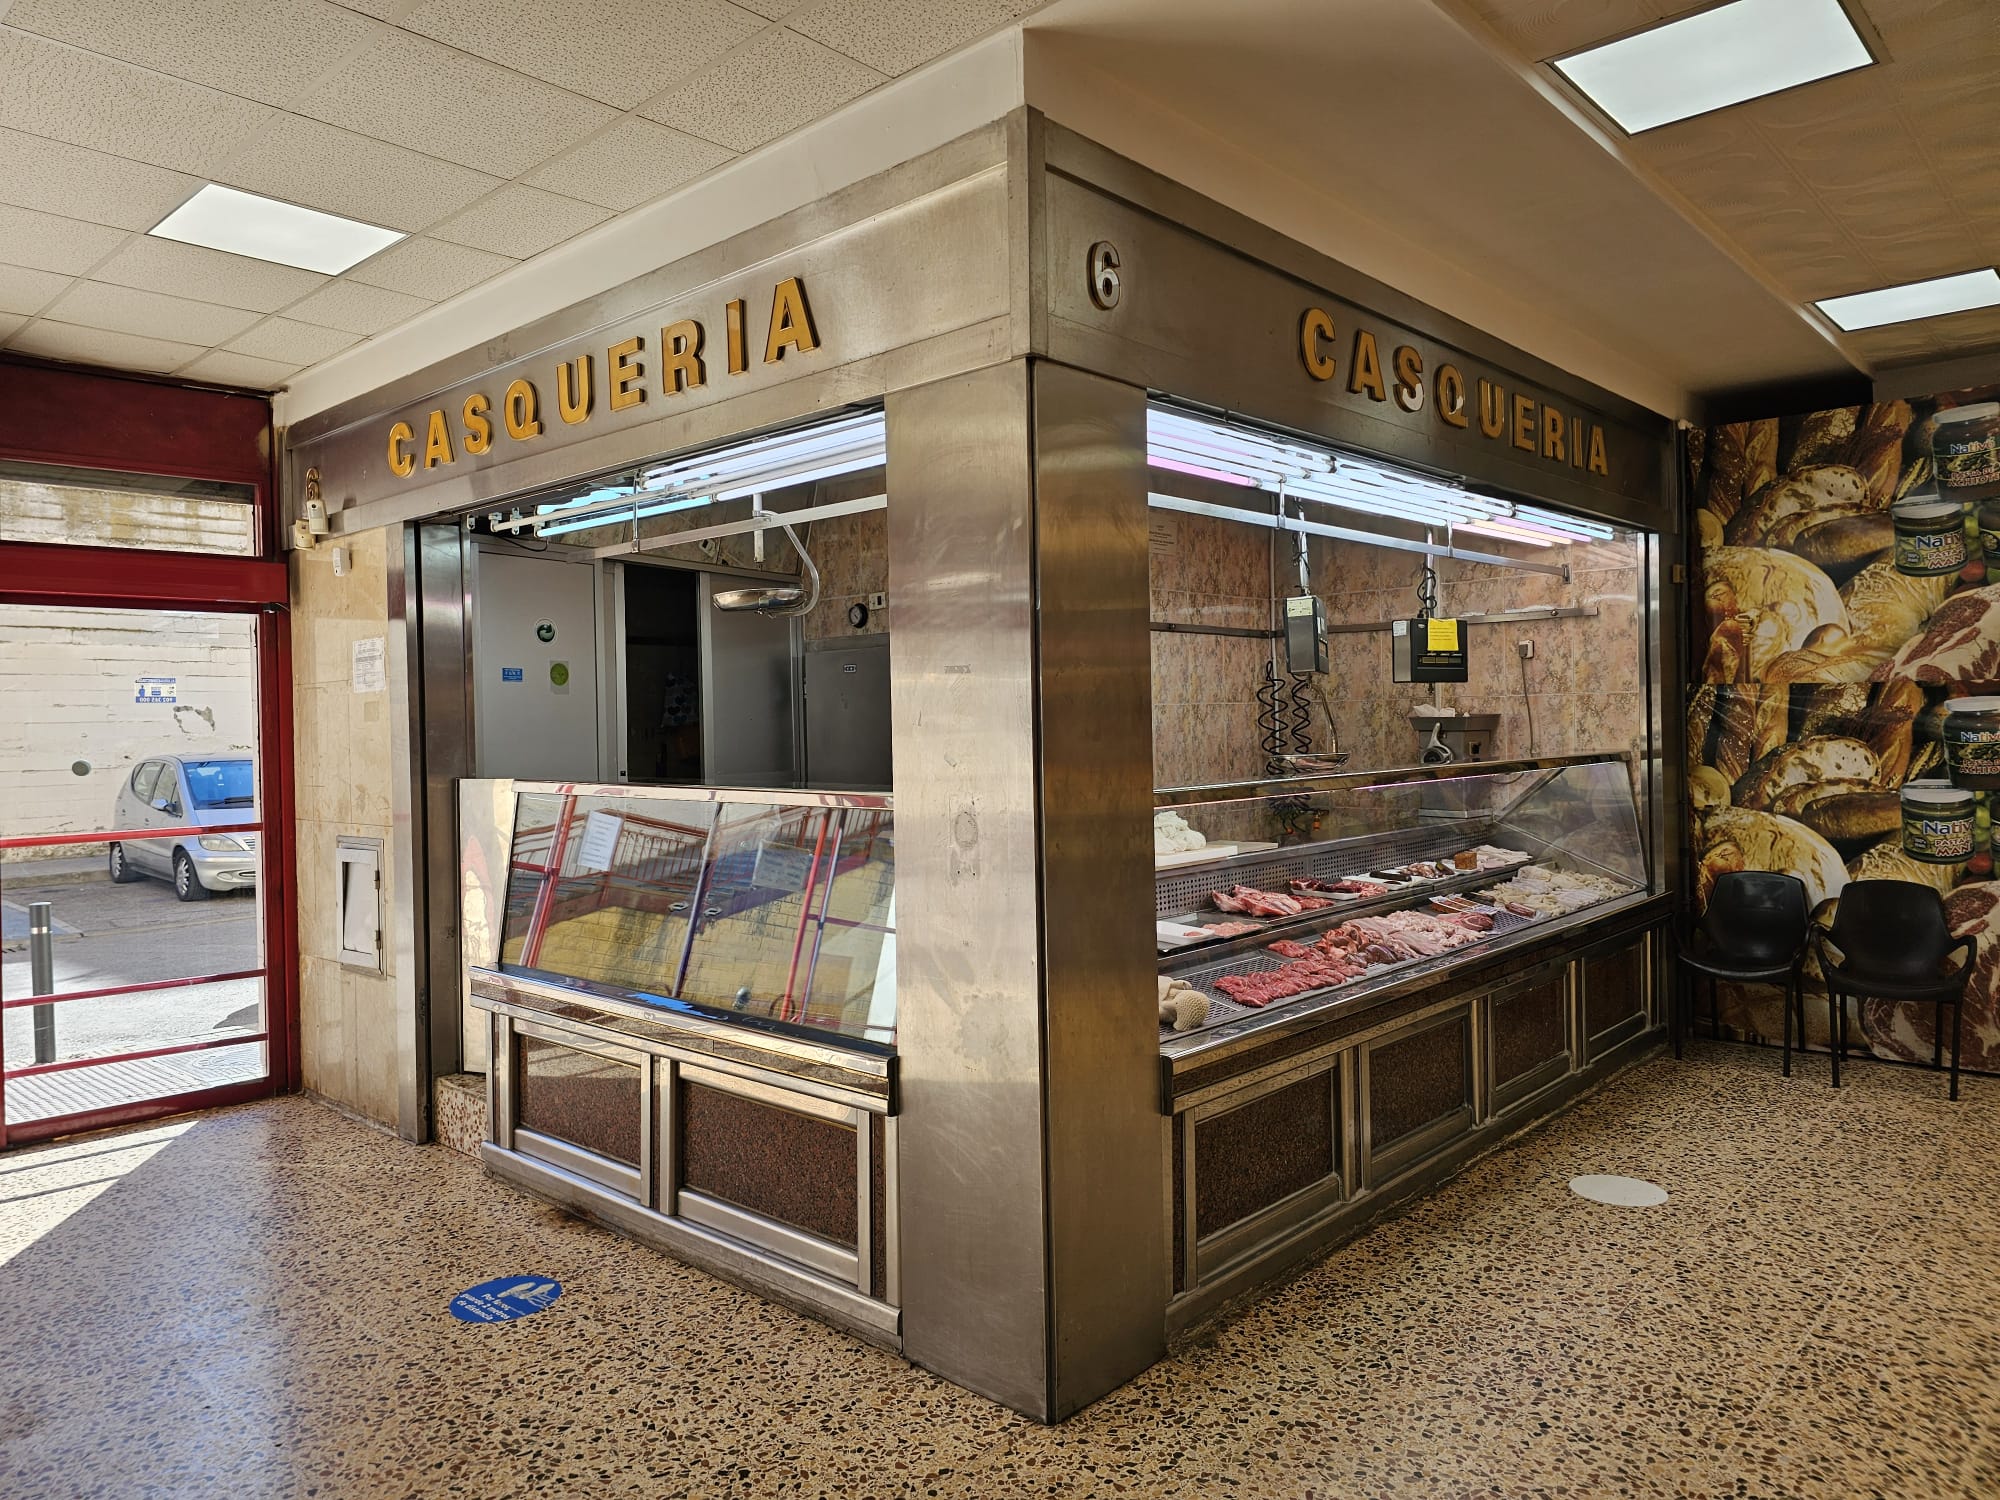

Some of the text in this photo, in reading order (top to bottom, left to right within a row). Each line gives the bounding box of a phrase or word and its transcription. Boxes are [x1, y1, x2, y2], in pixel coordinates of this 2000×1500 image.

[1088, 241, 1121, 310] 6
[387, 277, 821, 478] CASQUERIA
[1299, 307, 1609, 477] CASQUERIA
[1960, 766, 2000, 774] ACHIO
